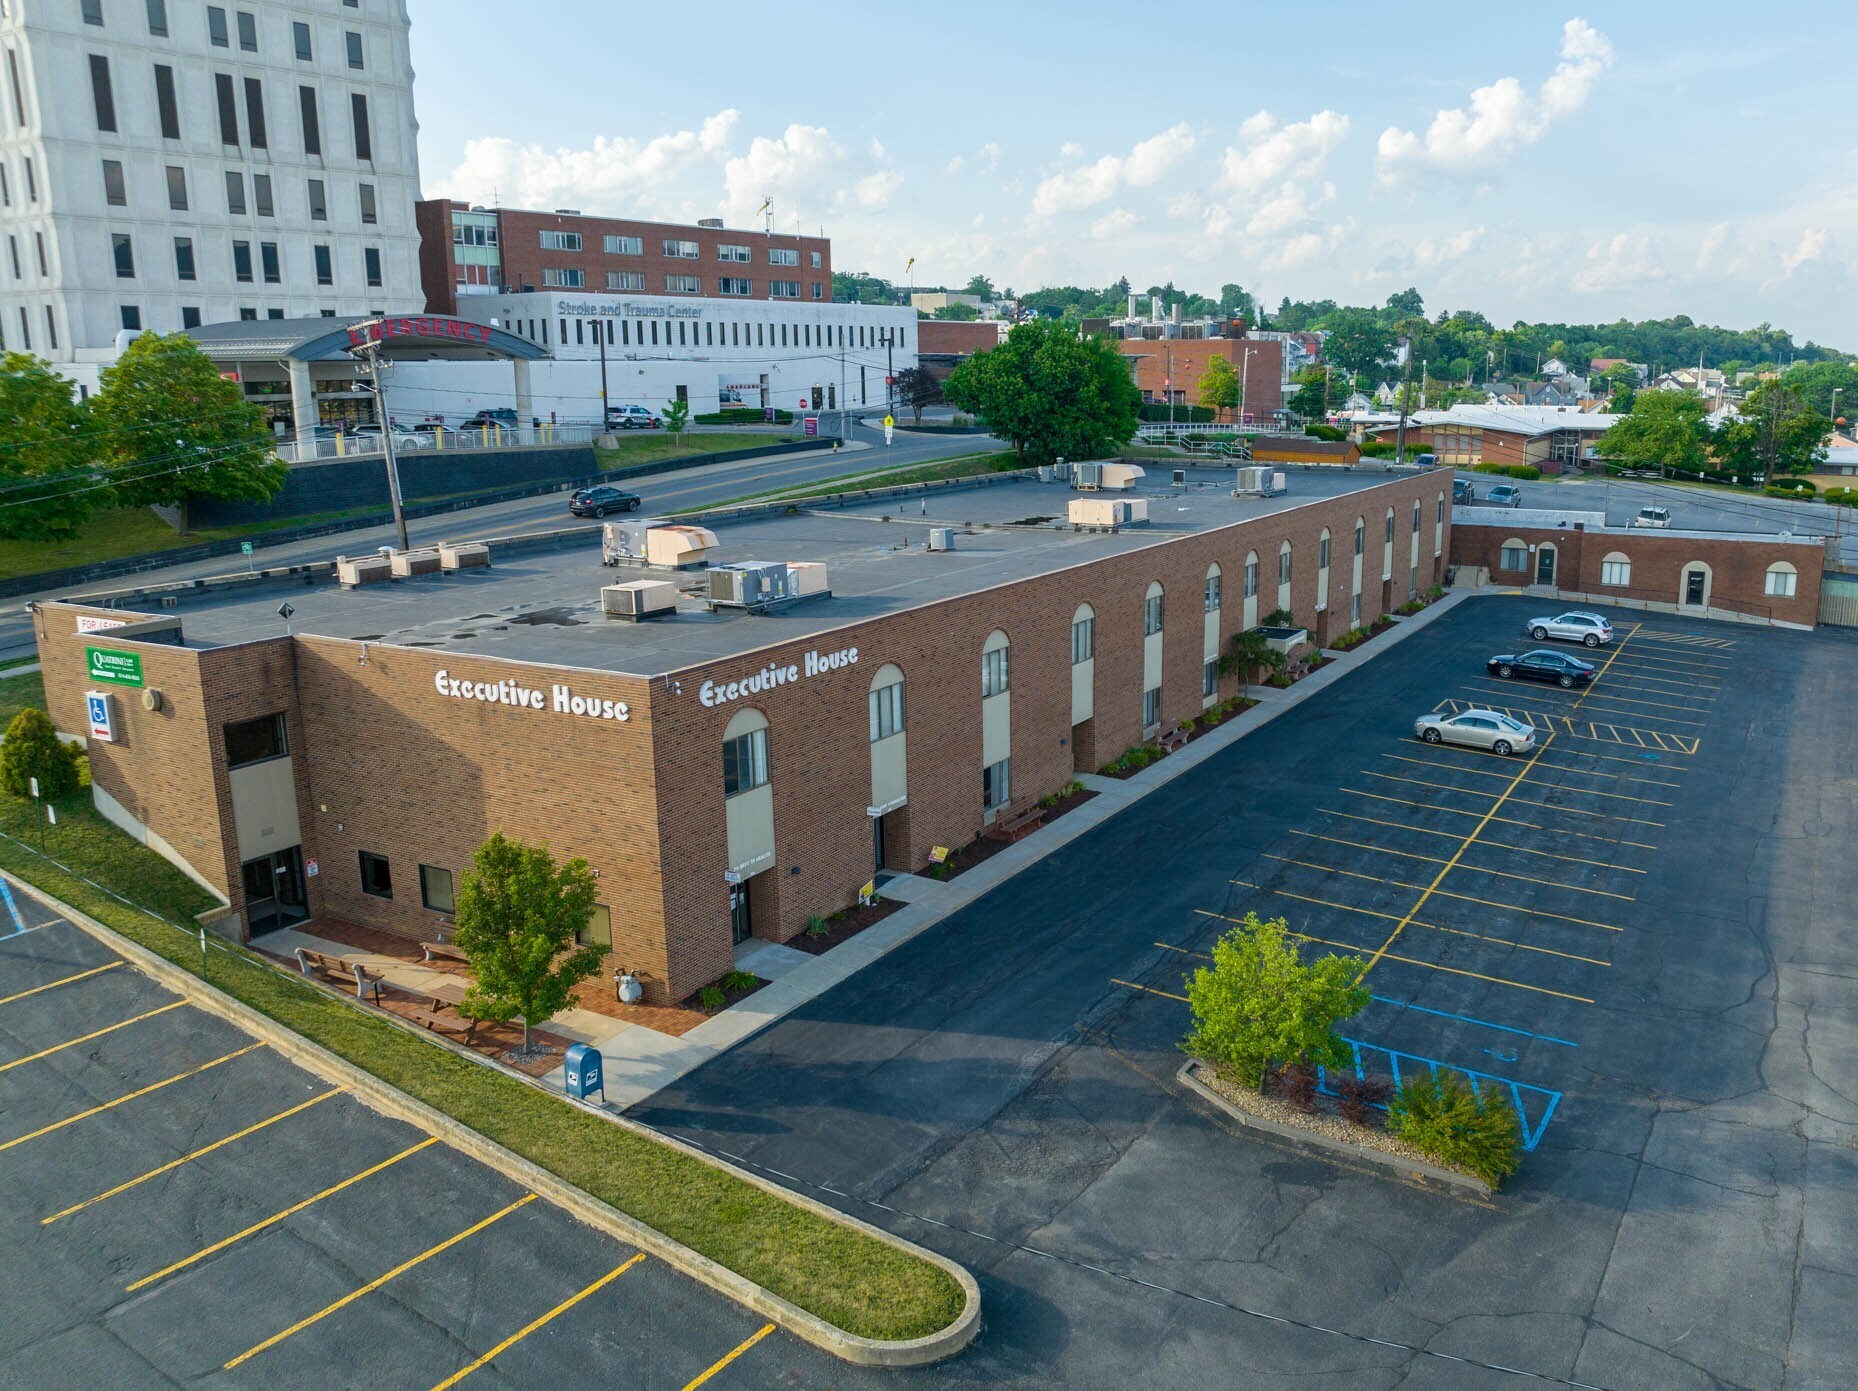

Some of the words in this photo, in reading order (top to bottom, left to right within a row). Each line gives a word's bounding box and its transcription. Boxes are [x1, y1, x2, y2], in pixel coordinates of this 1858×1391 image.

[558, 301, 598, 315] Stroke
[600, 302, 621, 316] and
[624, 303, 665, 318] Trauma
[667, 305, 703, 319] Center
[350, 317, 492, 345] EMERGENCY
[82, 619, 97, 629] FOR
[699, 661, 799, 708] Executive
[804, 647, 859, 678] House
[435, 669, 545, 710] Executive
[552, 684, 630, 722] House
